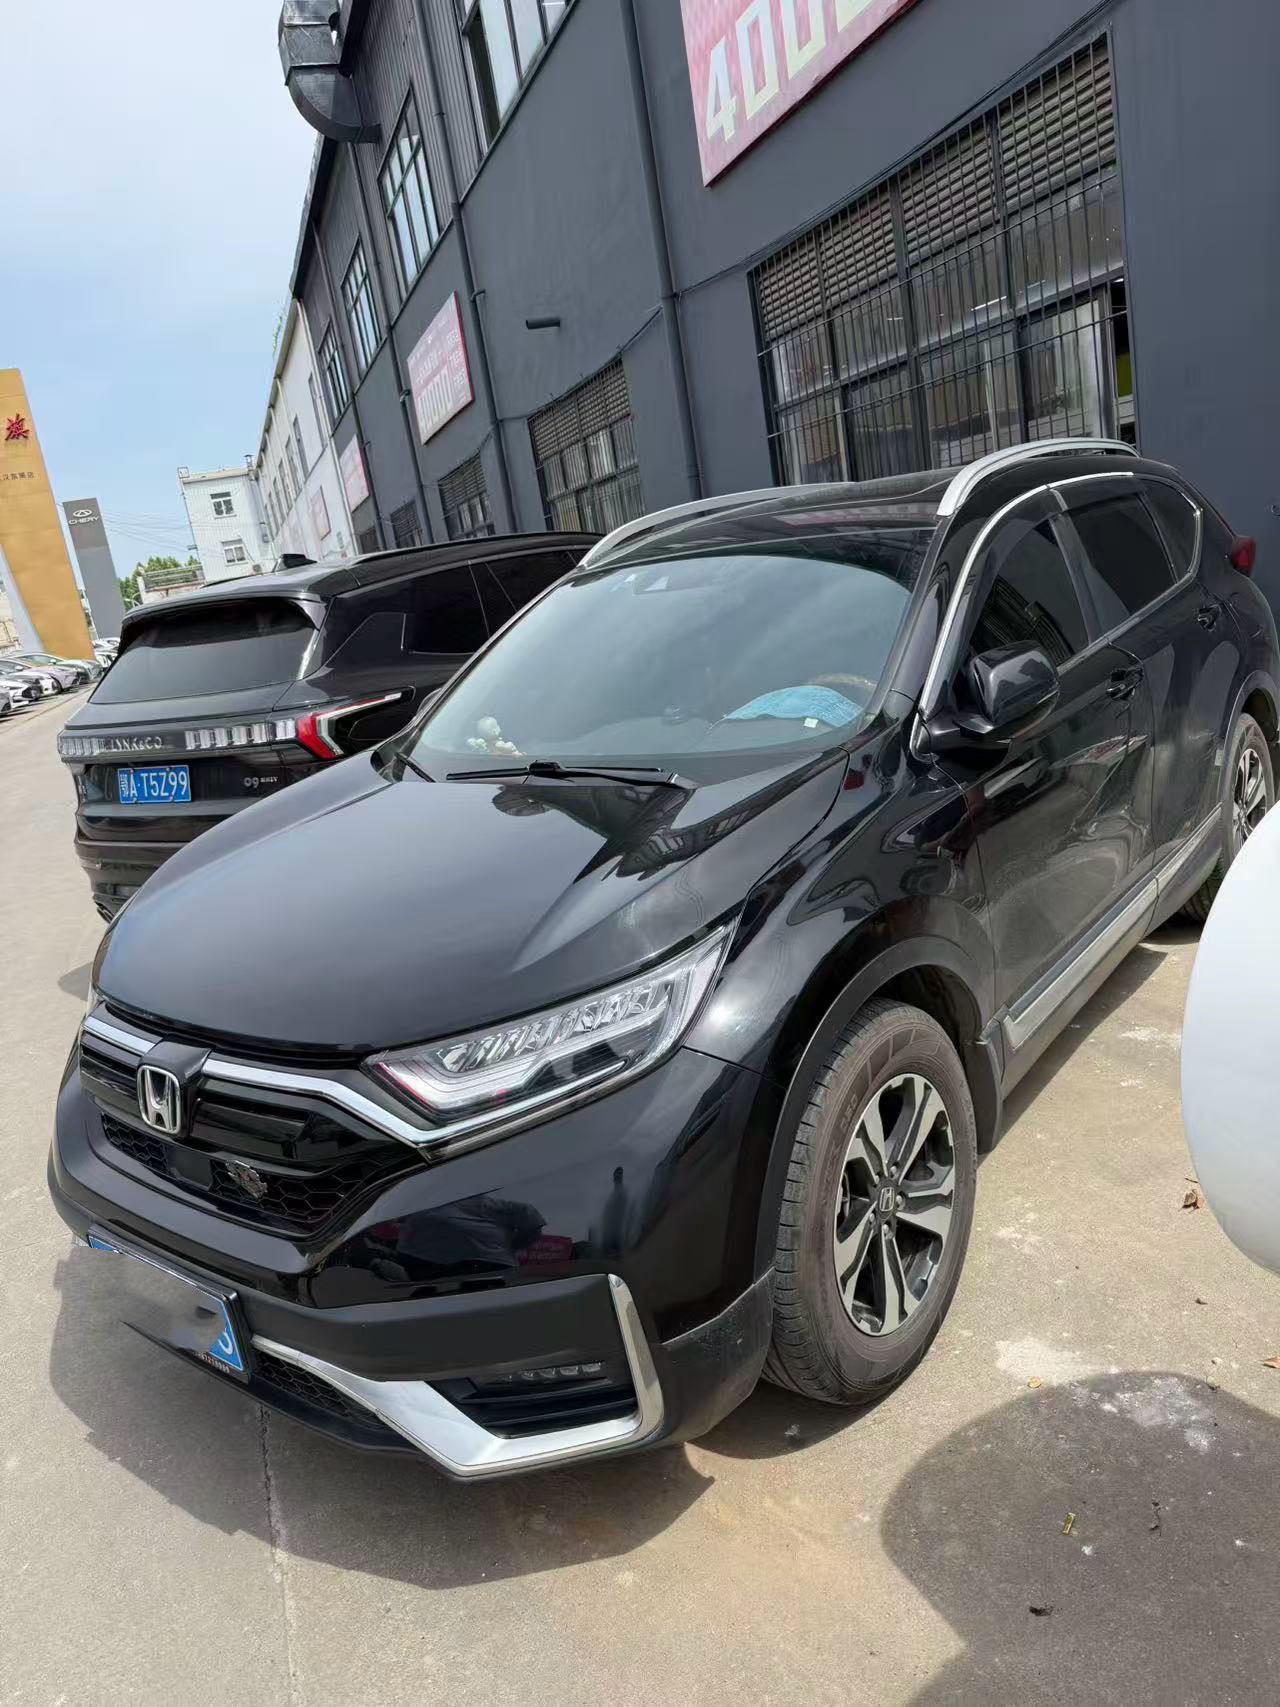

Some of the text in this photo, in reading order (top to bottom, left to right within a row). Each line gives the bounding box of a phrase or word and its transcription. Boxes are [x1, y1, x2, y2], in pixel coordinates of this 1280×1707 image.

[706, 0, 874, 143] 400
[68, 515, 99, 525] CHERY
[243, 776, 260, 788] 09
